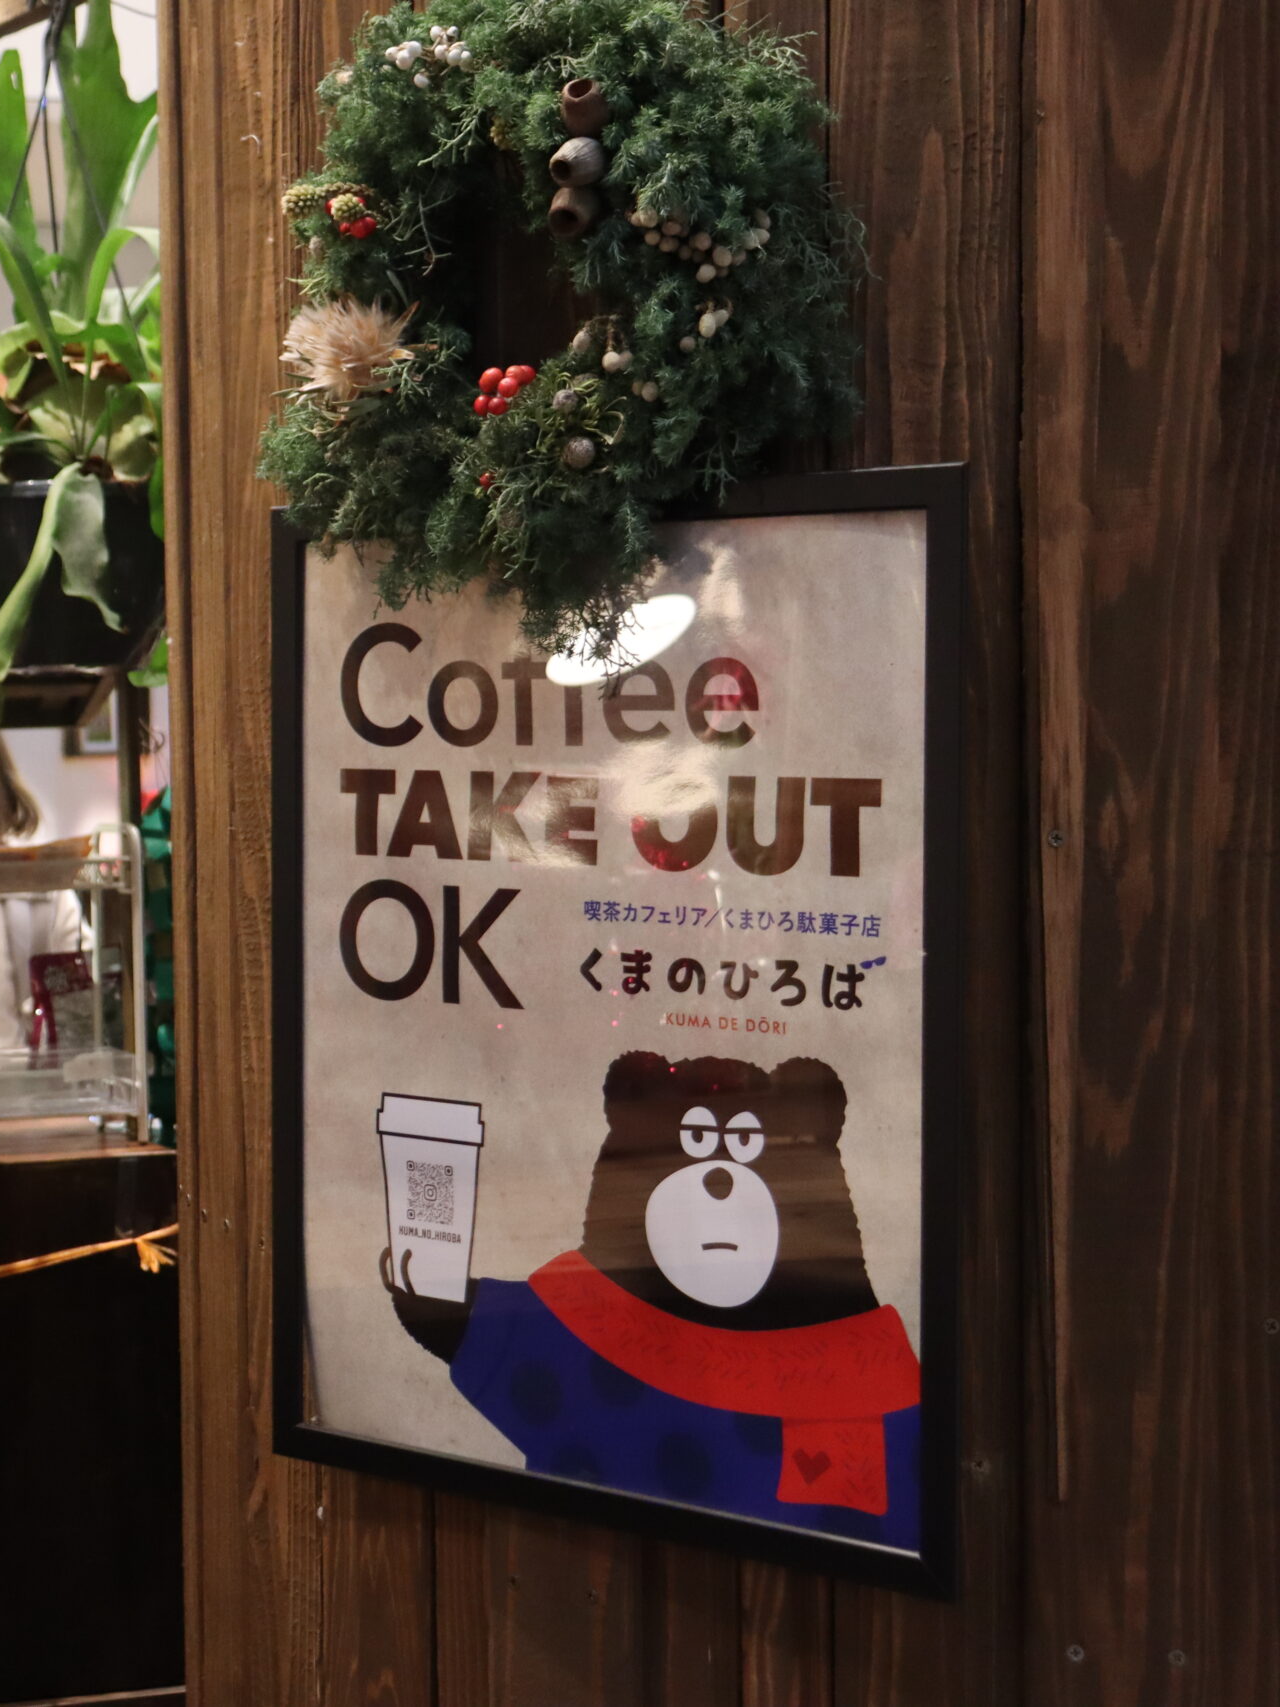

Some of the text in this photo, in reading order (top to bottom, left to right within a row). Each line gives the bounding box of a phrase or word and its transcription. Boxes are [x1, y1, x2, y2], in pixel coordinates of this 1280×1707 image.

[340, 768, 883, 878] TAKE OUT
[339, 879, 526, 1011] OK
[665, 1012, 712, 1029] KUMA
[718, 1017, 739, 1031] DE
